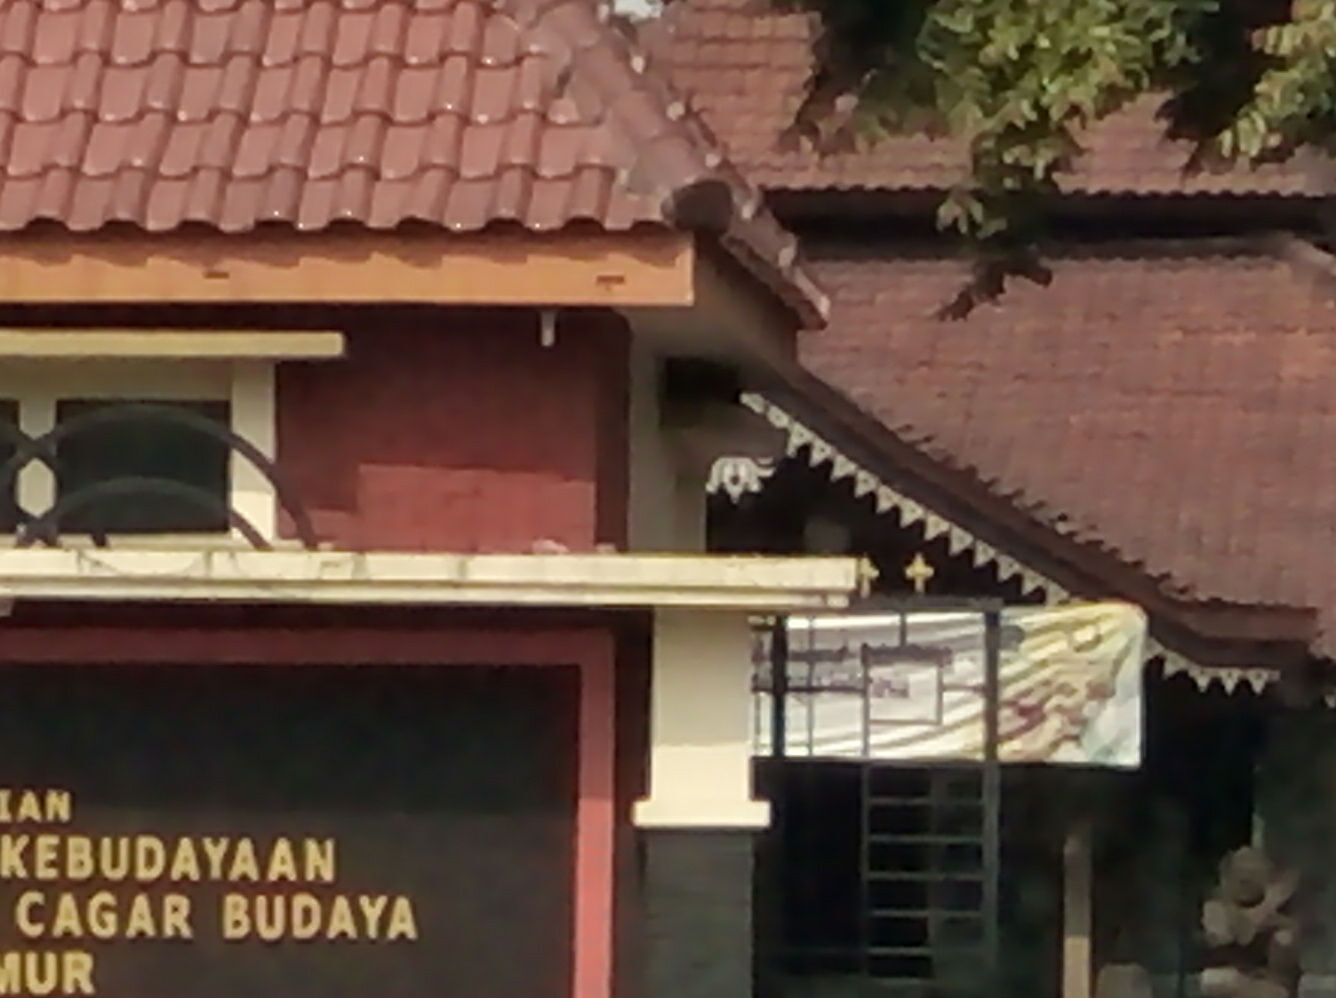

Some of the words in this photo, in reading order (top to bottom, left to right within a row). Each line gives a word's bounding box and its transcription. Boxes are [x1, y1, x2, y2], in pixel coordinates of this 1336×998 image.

[0, 835, 336, 882] KEBUDAYAAN
[15, 892, 193, 940] CAGAR
[222, 894, 418, 941] BUDAYA
